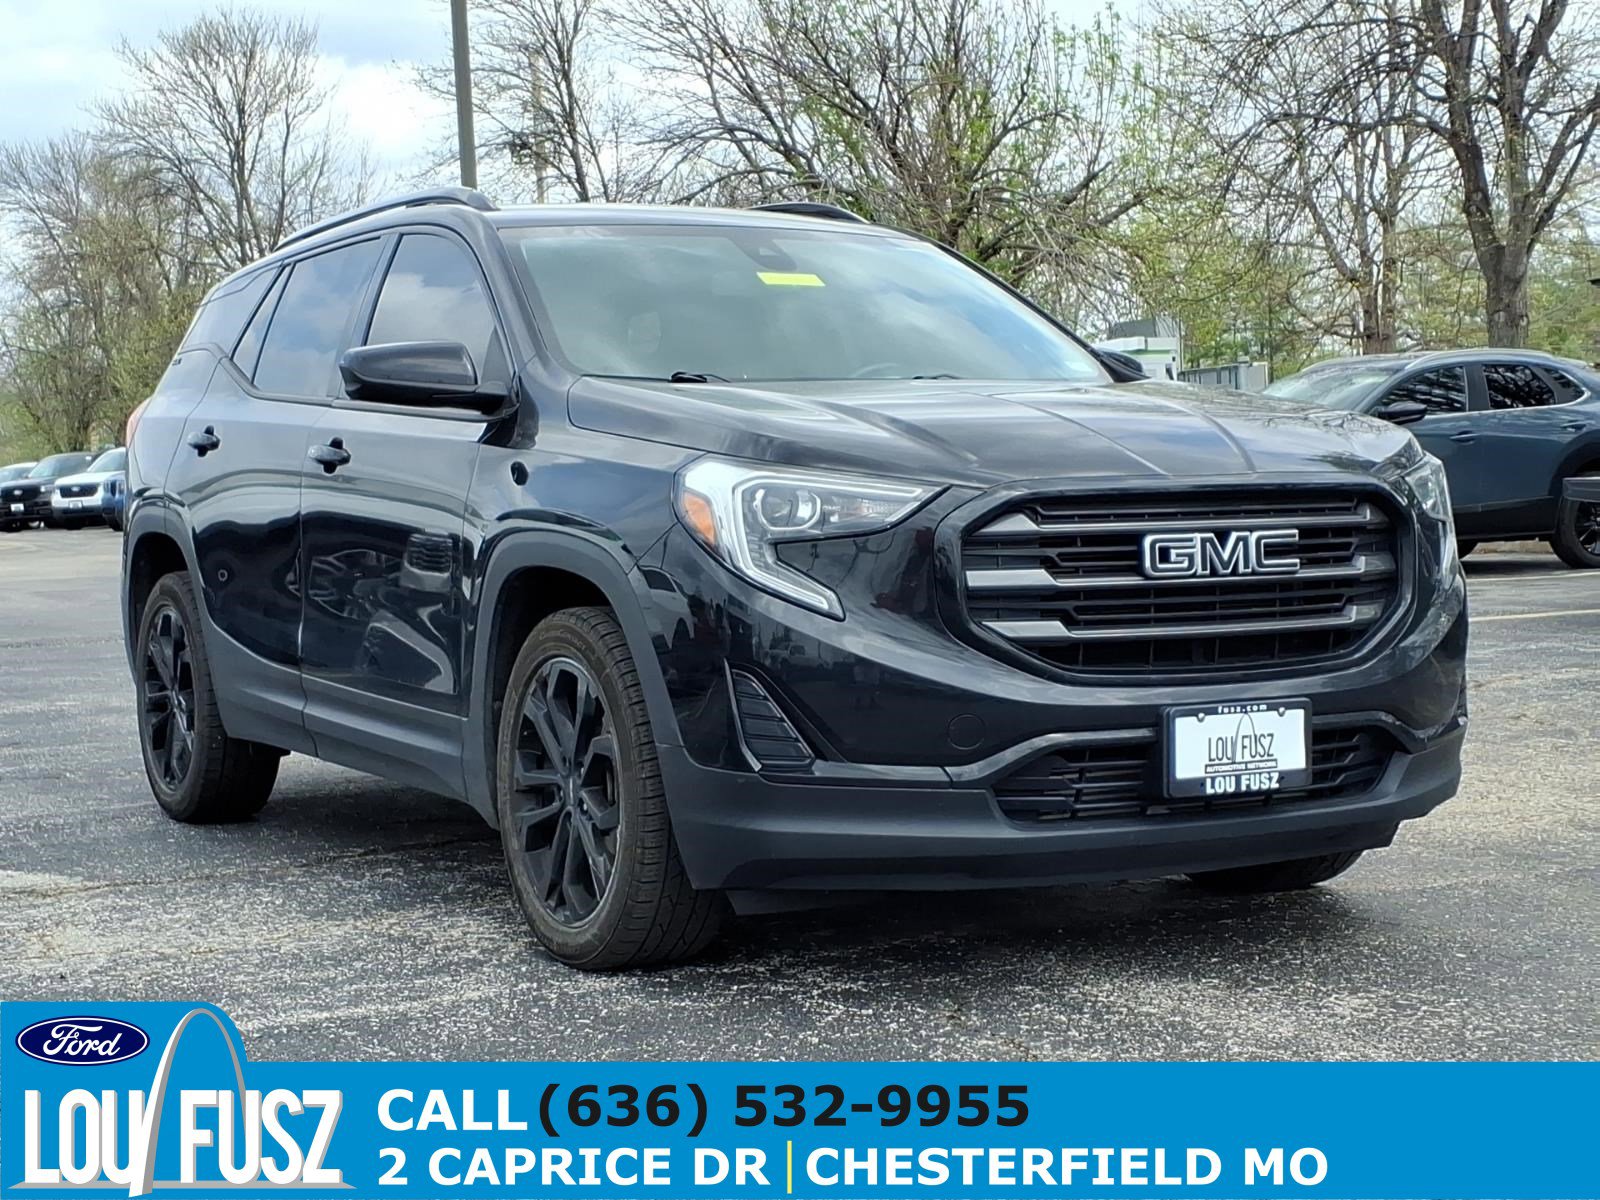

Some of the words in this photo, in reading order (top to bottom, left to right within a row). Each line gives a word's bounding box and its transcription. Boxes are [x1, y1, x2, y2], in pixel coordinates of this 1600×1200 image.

[1144, 529, 1300, 578] GMC
[1218, 704, 1267, 714] fusz.com
[1208, 735, 1235, 762] LOU
[1241, 732, 1274, 760] FUSZ
[1205, 775, 1236, 795] LOU
[1241, 772, 1280, 792] FUSZ
